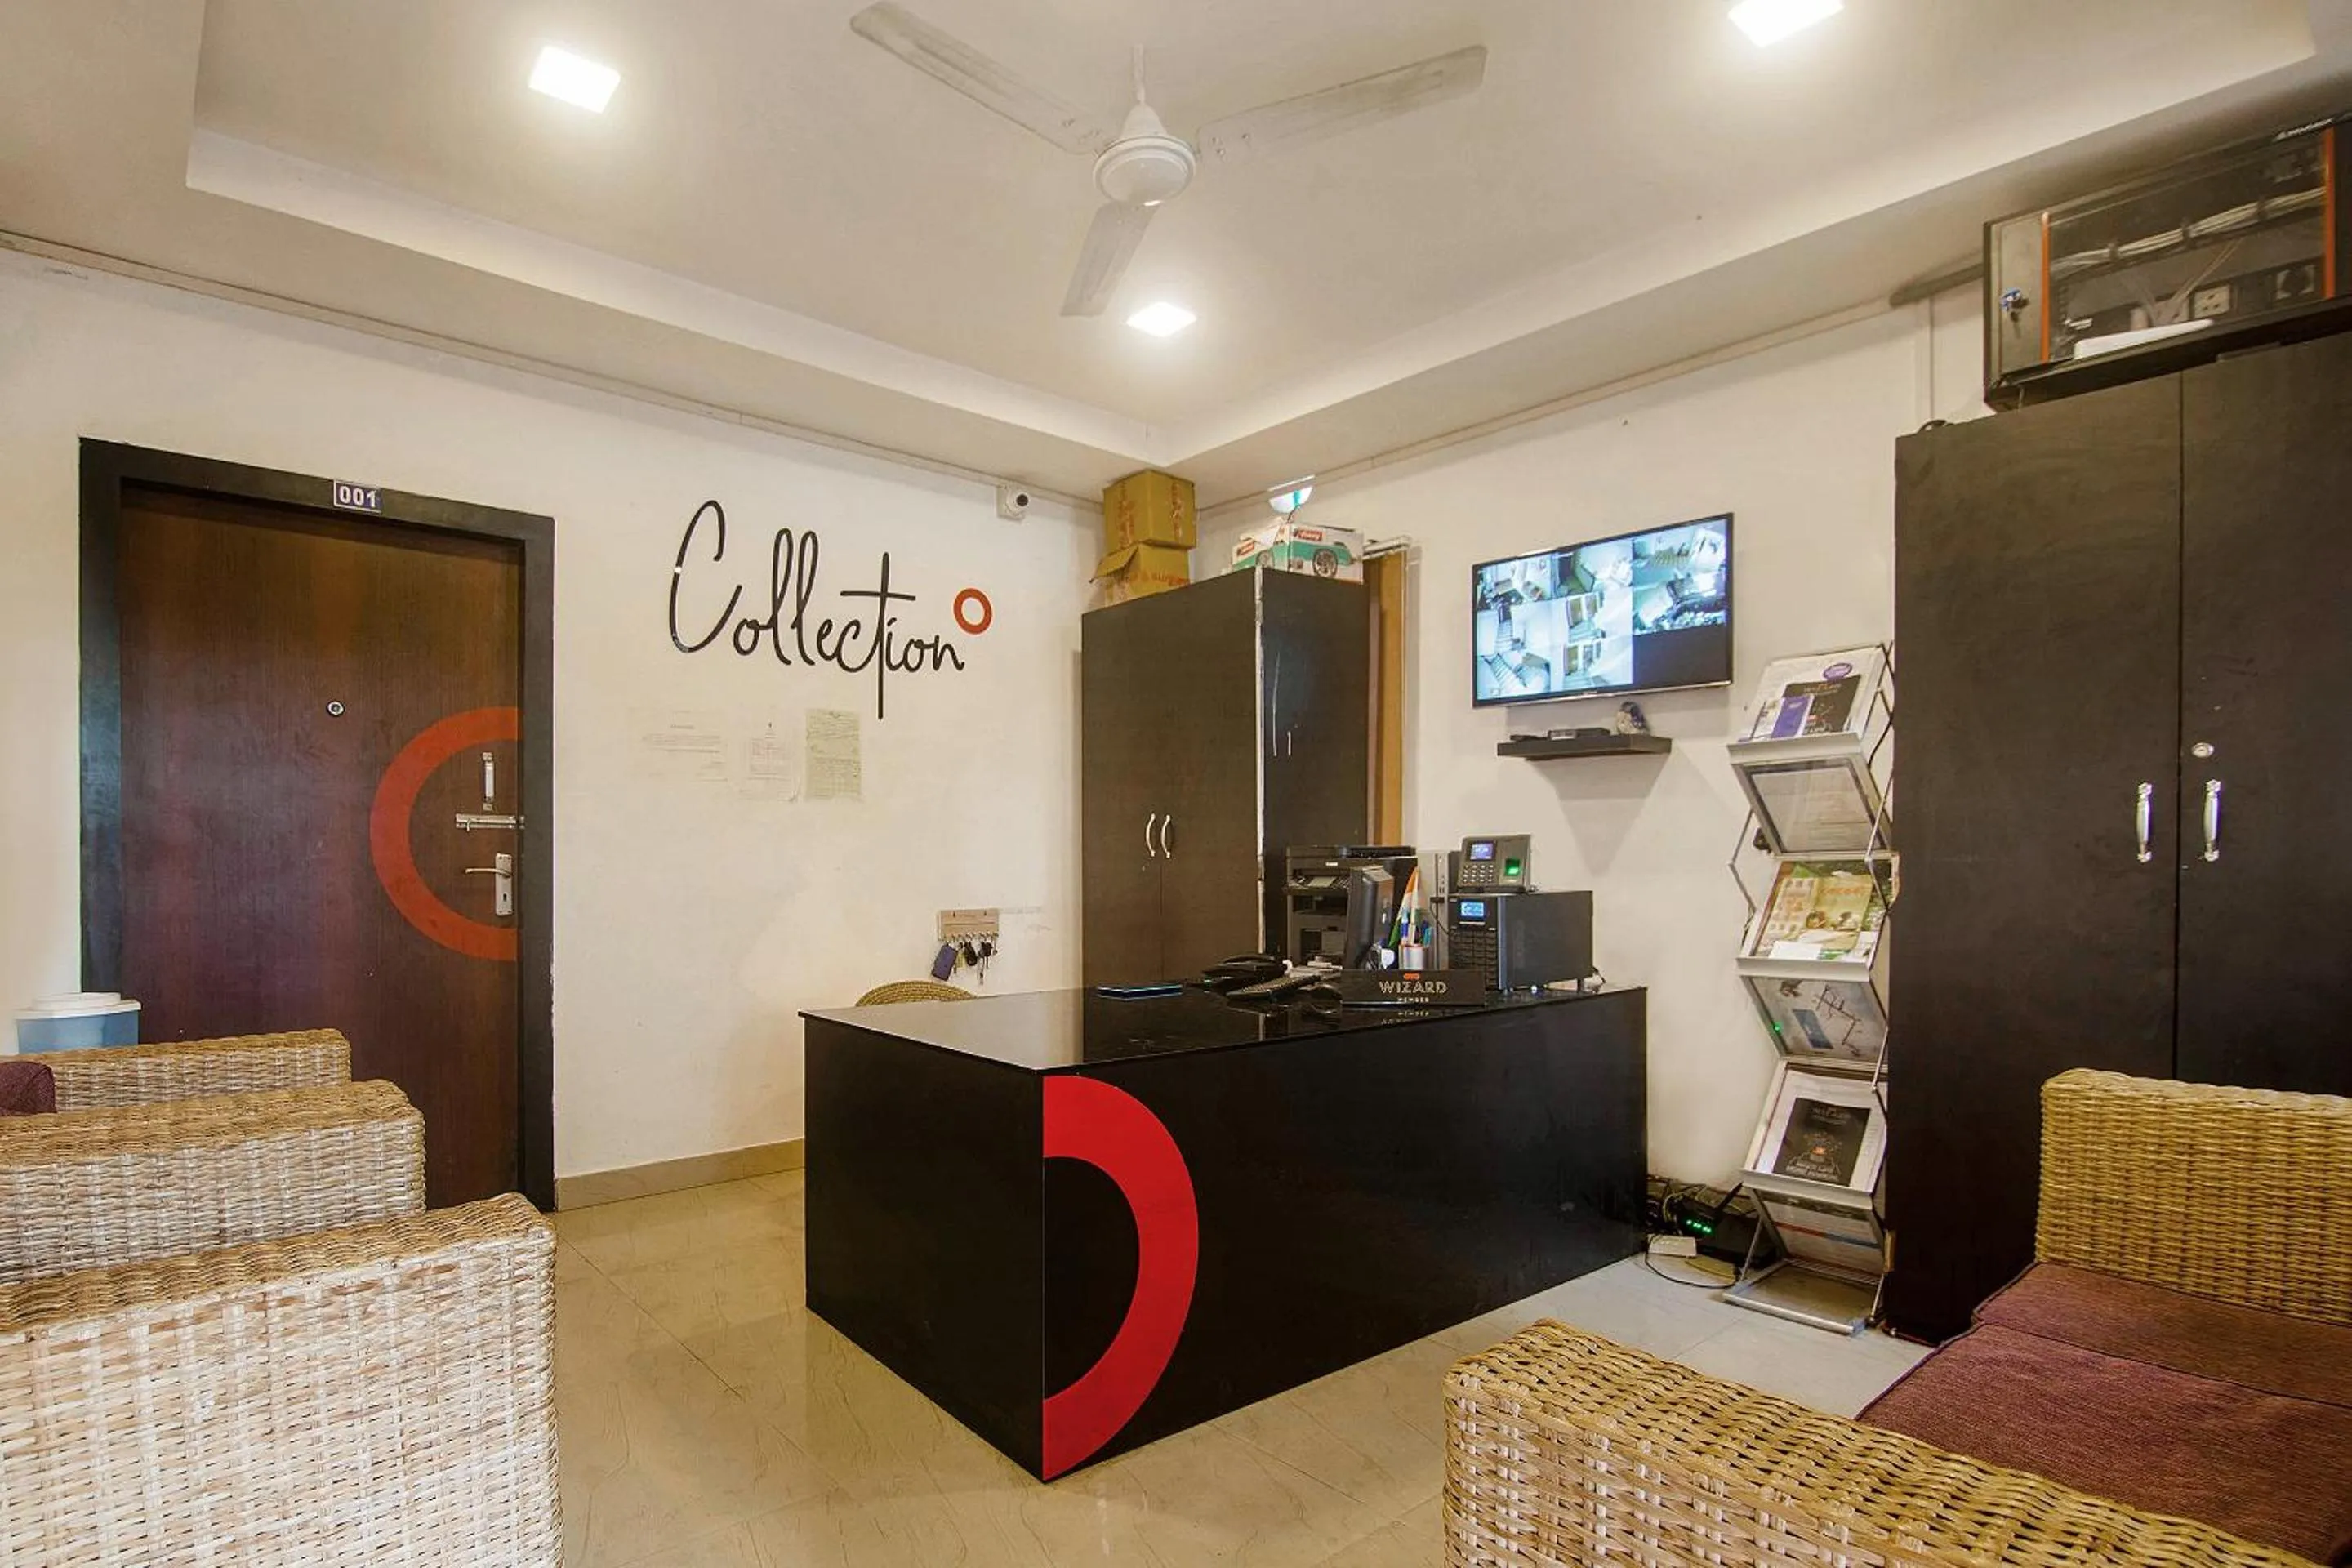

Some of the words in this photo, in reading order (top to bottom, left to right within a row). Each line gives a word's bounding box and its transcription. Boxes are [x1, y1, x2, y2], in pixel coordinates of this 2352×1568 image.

[339, 485, 376, 508] 001
[669, 500, 965, 720] Collection
[1379, 980, 1448, 994] WIZARD
